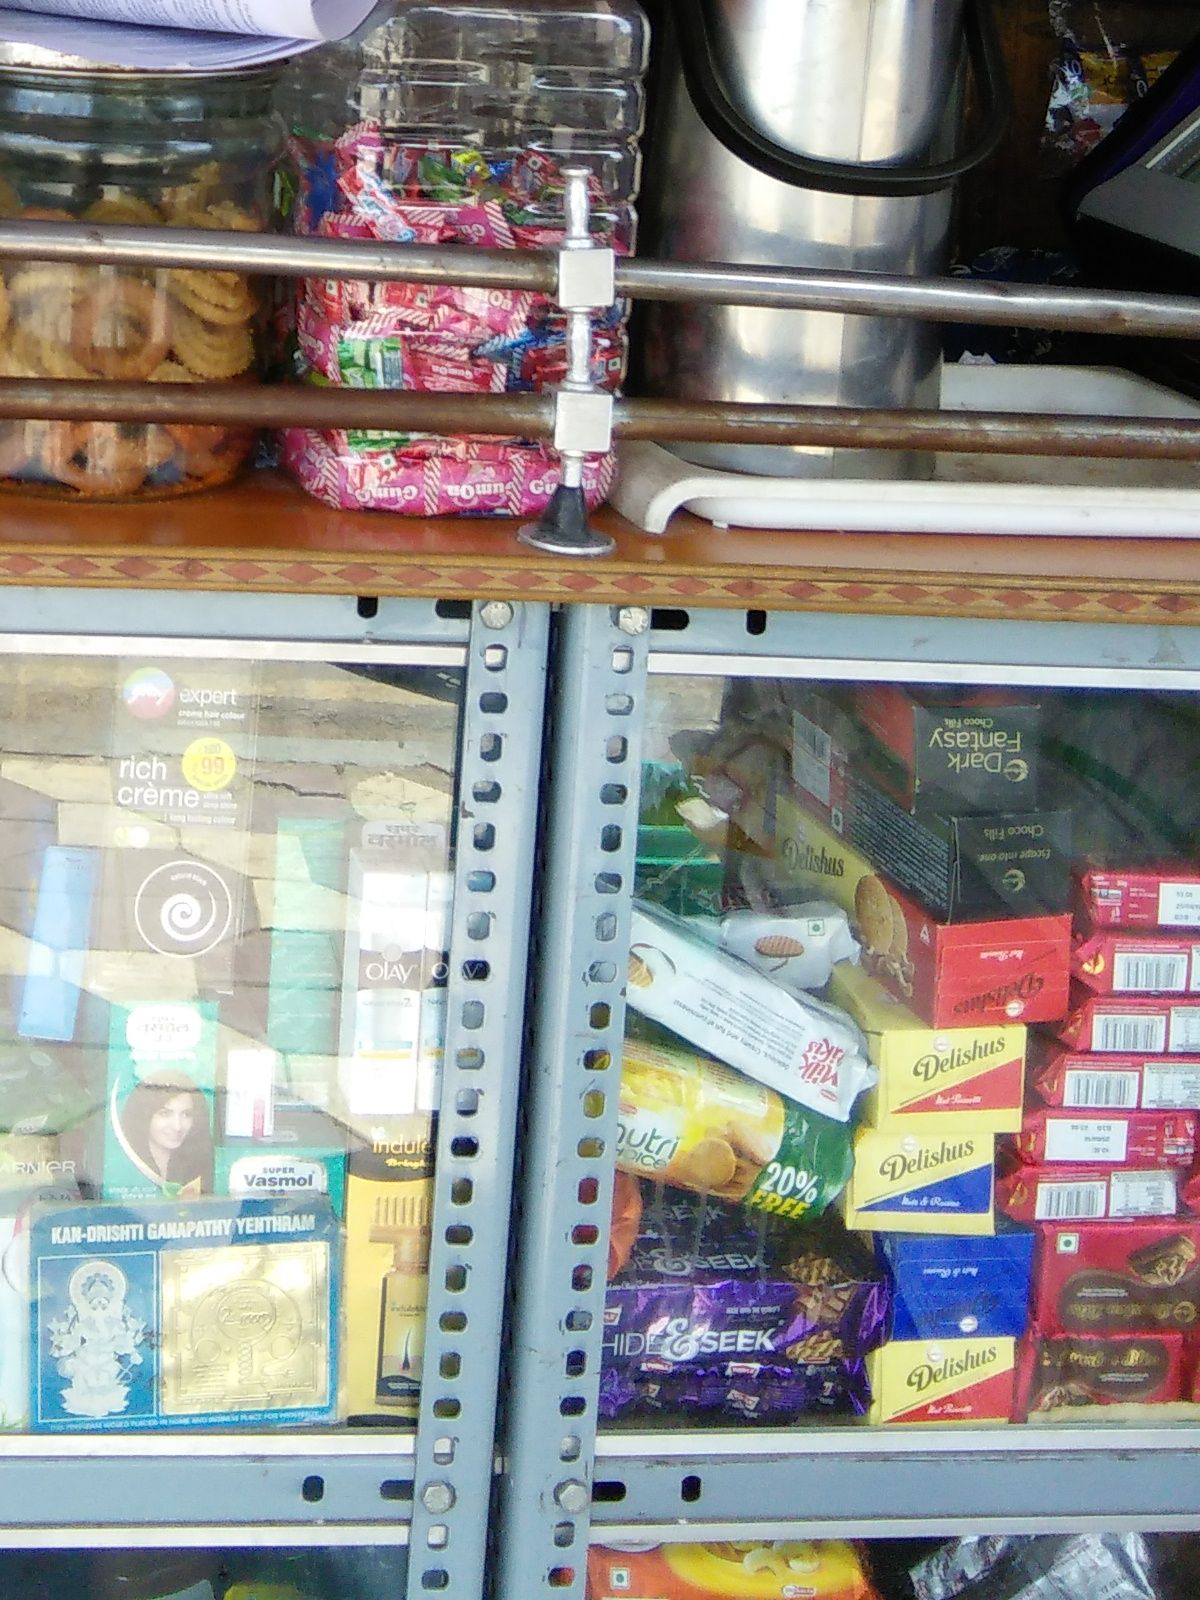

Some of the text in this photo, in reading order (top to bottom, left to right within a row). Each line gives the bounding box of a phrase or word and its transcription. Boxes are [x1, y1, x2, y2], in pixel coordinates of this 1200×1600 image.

[179, 687, 238, 706] expert
[928, 727, 1022, 753] Fantasy
[118, 755, 168, 781] rich
[947, 751, 1002, 774] Dark
[117, 782, 200, 809] crème
[1012, 824, 1044, 837] Choco
[912, 1032, 1007, 1084] Delishus
[262, 1166, 295, 1174] SUPER
[877, 1135, 976, 1183] Delishus
[242, 1174, 314, 1189] Vasmol
[764, 1161, 819, 1205] 20%
[751, 1187, 809, 1221] FREE
[50, 1214, 316, 1245] KAN-DRISHTI GANAPATHY YENTHRAM
[701, 1328, 777, 1353] SEEK
[906, 1341, 998, 1393] Delishus
